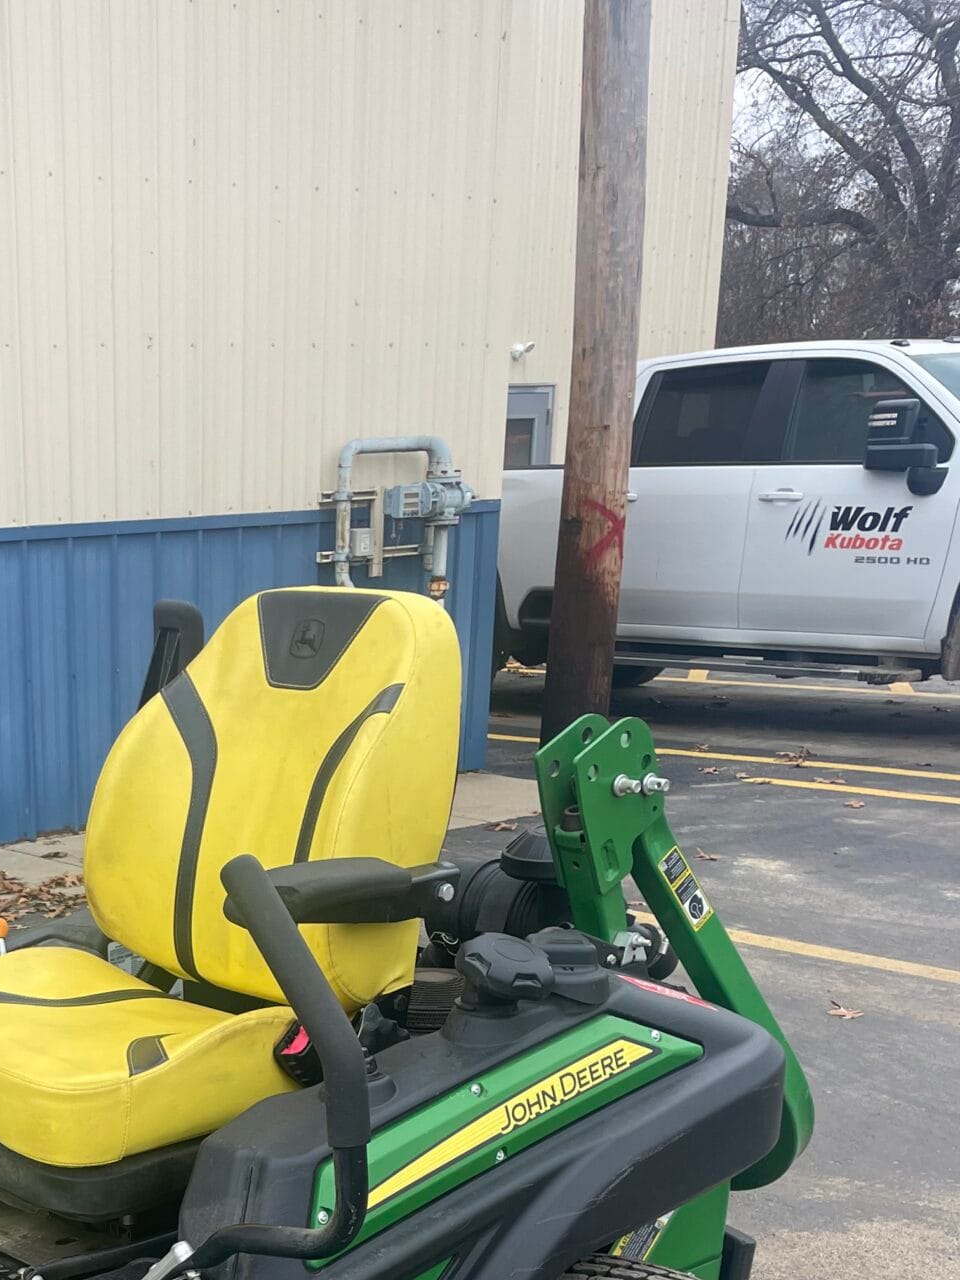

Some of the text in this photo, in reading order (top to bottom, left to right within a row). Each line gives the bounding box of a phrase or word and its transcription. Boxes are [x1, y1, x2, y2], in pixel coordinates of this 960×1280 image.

[829, 505, 913, 532] Wolf
[824, 533, 903, 550] Kubota
[854, 556, 930, 565] 2500 HD
[501, 1049, 627, 1131] JOHN DEERE
